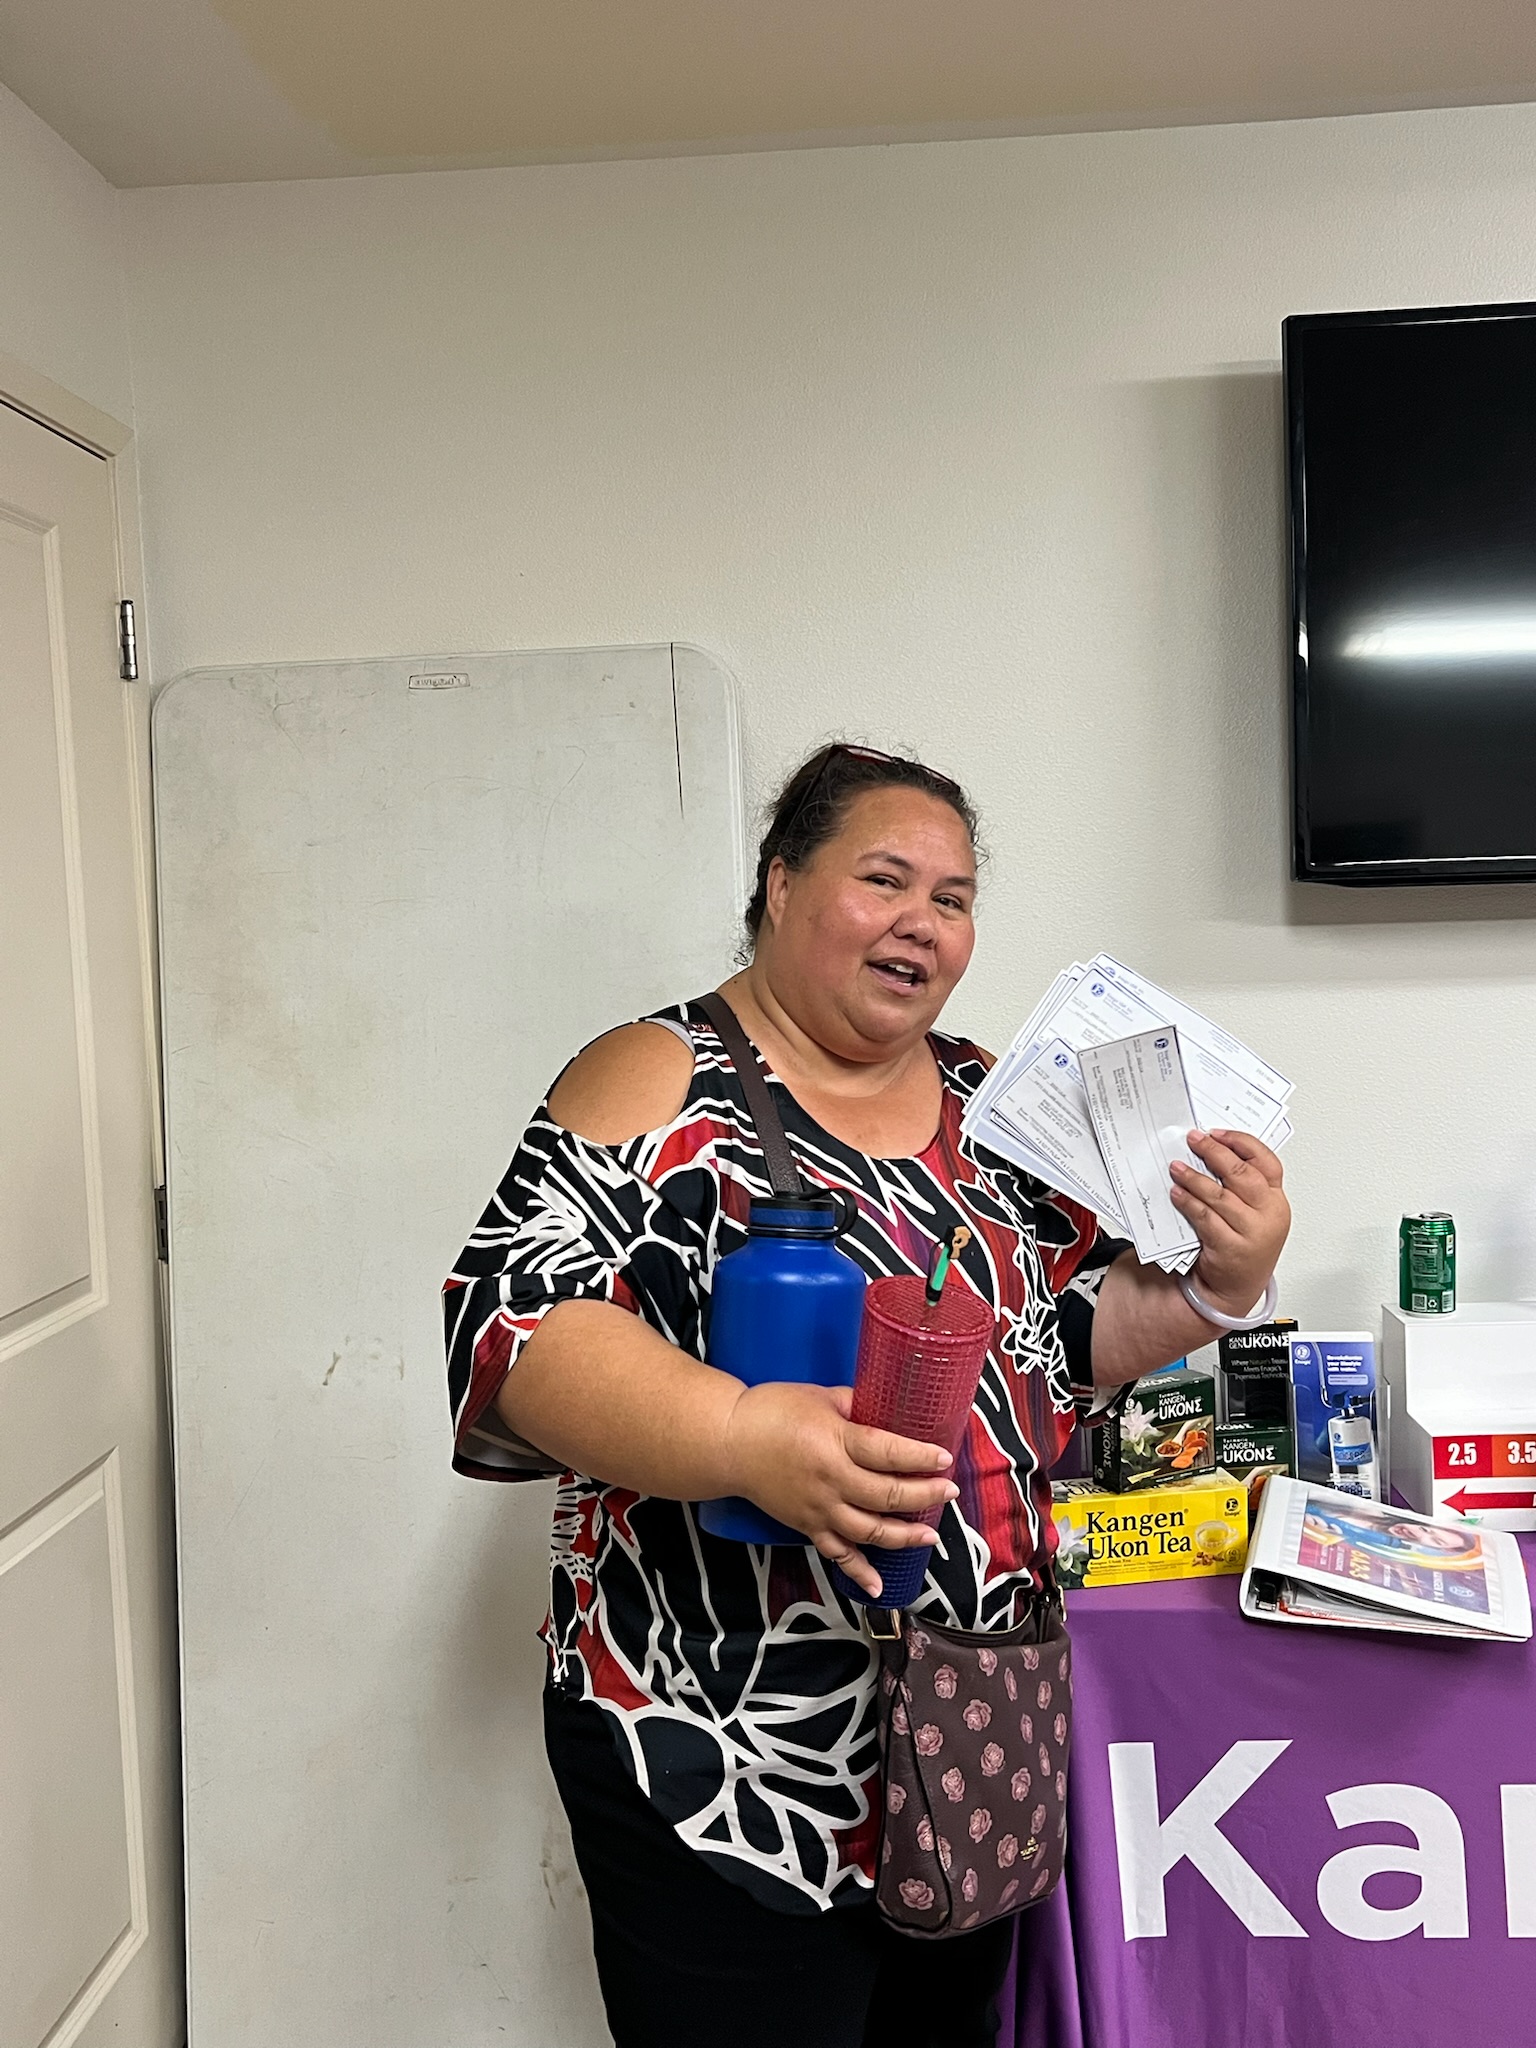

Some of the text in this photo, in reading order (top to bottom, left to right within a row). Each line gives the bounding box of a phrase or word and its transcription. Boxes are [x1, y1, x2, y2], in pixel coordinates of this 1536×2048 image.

[1159, 1394, 1186, 1407] KANGEN
[1223, 1441, 1255, 1451] KANGEN
[1448, 1440, 1536, 1466] 2.5 3.5
[1086, 1531, 1192, 1560] Ukon Tea
[1108, 1739, 1536, 1942] Ka
